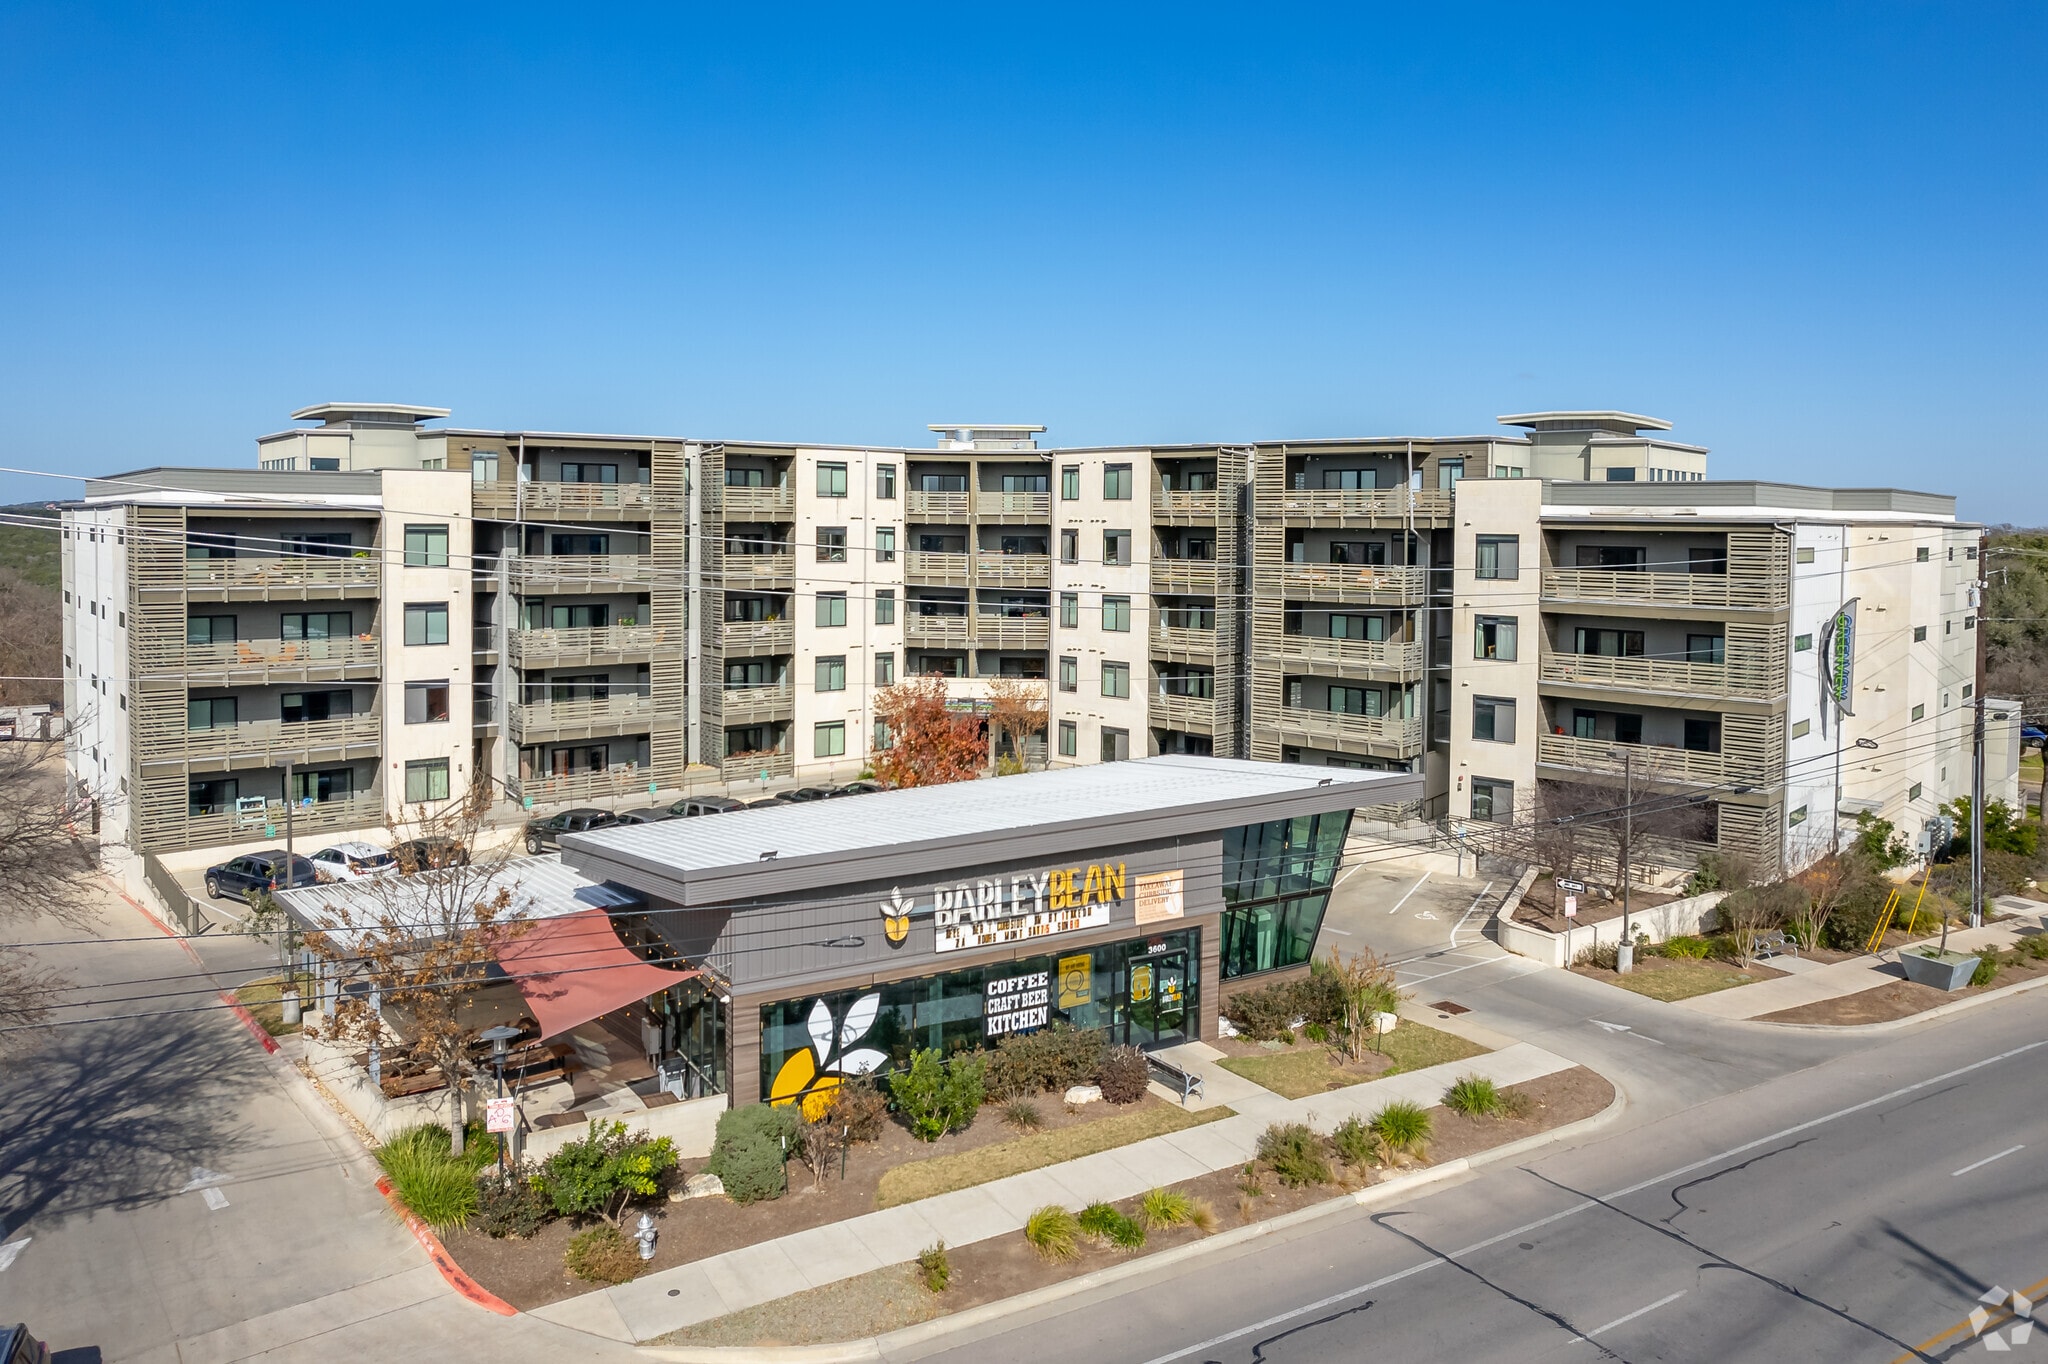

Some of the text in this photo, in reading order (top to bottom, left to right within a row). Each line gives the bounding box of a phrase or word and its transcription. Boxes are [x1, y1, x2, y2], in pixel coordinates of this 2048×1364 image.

[1834, 612, 1852, 701] GREENVIEW
[1139, 896, 1170, 907] DELIVERY
[1148, 943, 1166, 954] 3600
[987, 971, 1048, 996] COFFEE
[988, 988, 1048, 1015] CRAFT BEER
[987, 1005, 1048, 1036] KITCHEN
